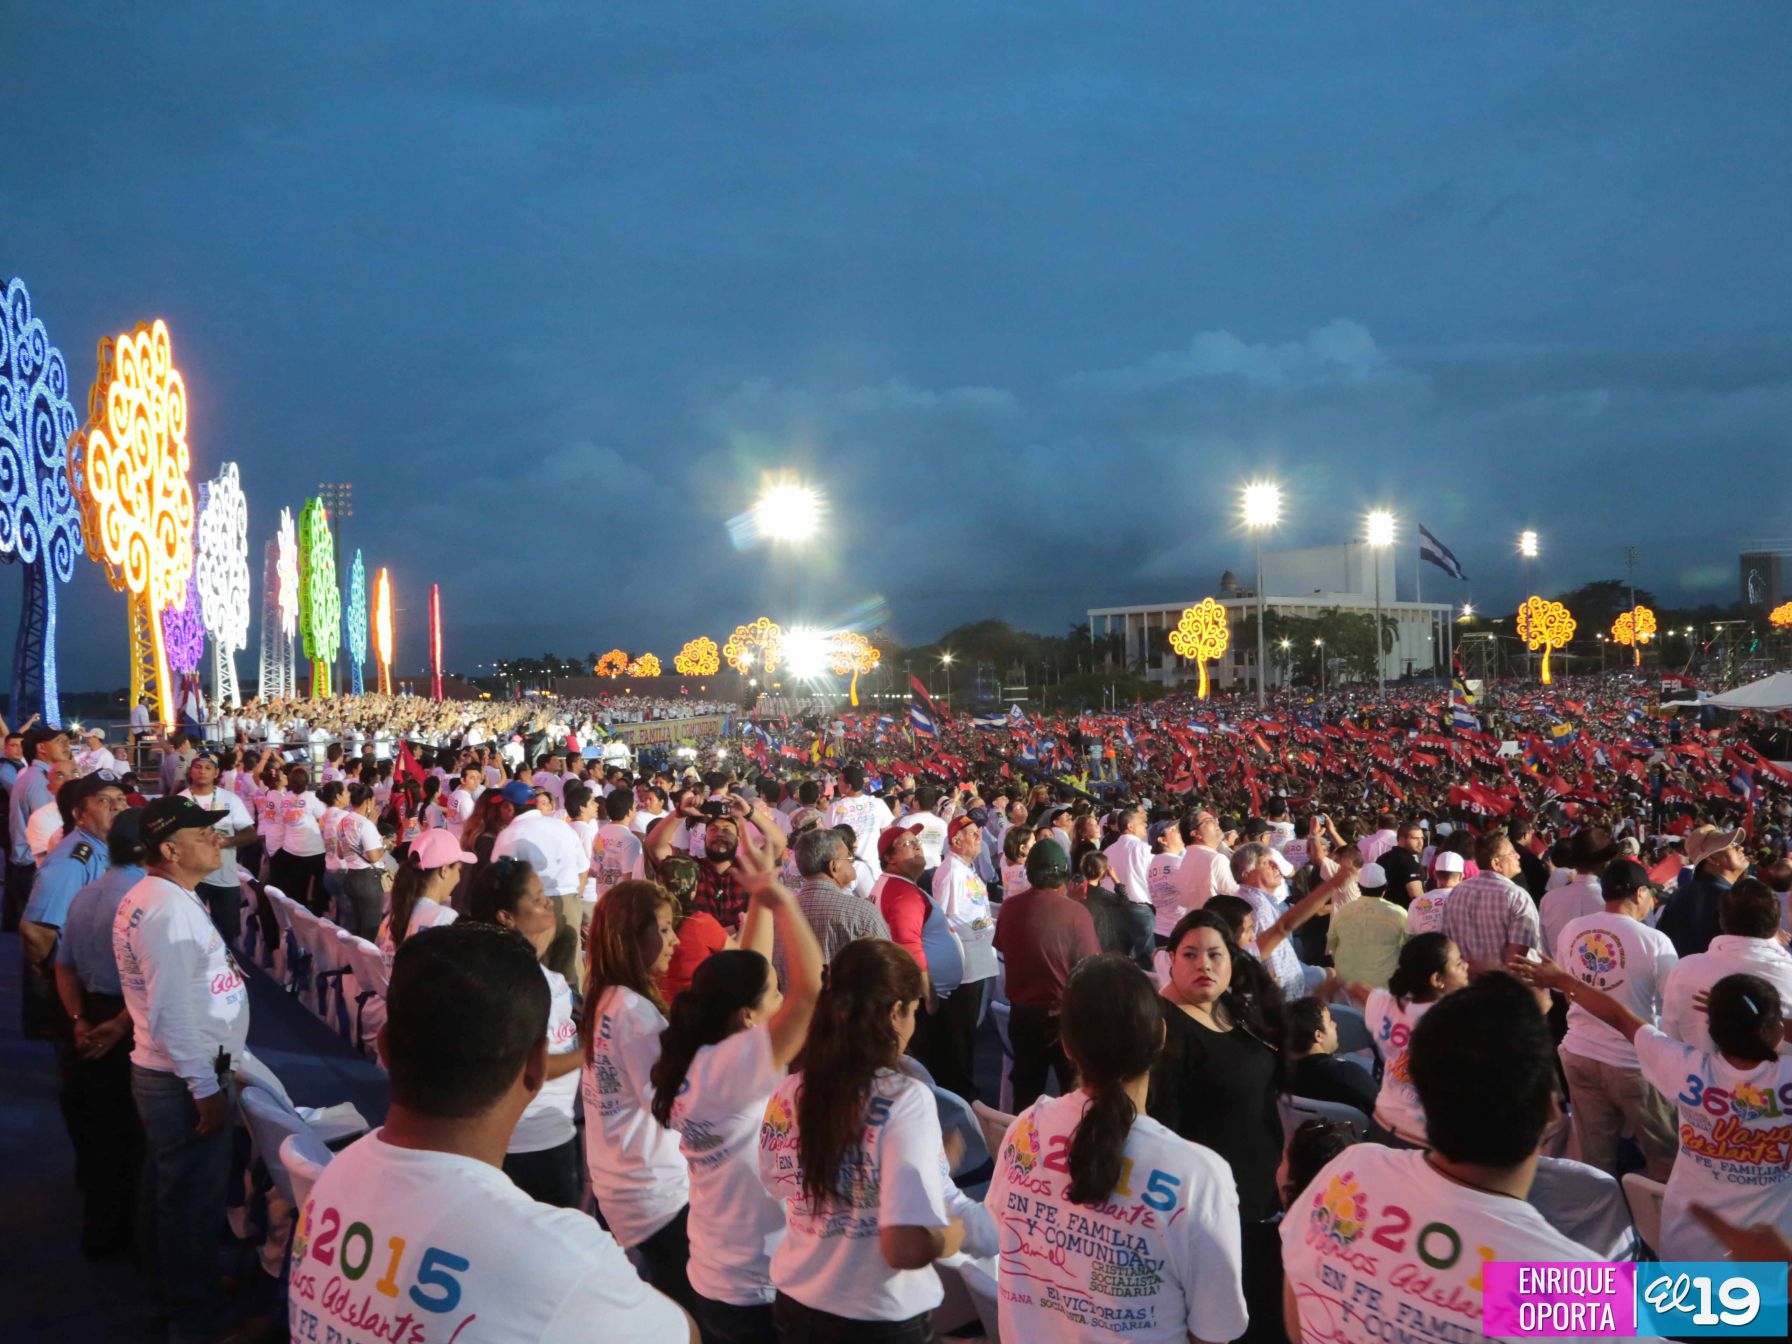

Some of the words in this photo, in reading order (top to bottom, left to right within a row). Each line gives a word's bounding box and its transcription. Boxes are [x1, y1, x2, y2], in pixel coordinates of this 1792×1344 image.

[1379, 1015, 1411, 1048] 36
[1678, 1074, 1730, 1116] 36
[1043, 1135, 1182, 1211] 215
[1007, 1191, 1030, 1214] EN
[1066, 1212, 1150, 1255] FAMILIA
[1026, 1217, 1038, 1237] Y
[312, 1207, 470, 1314] 2015
[1321, 1264, 1347, 1292] EN
